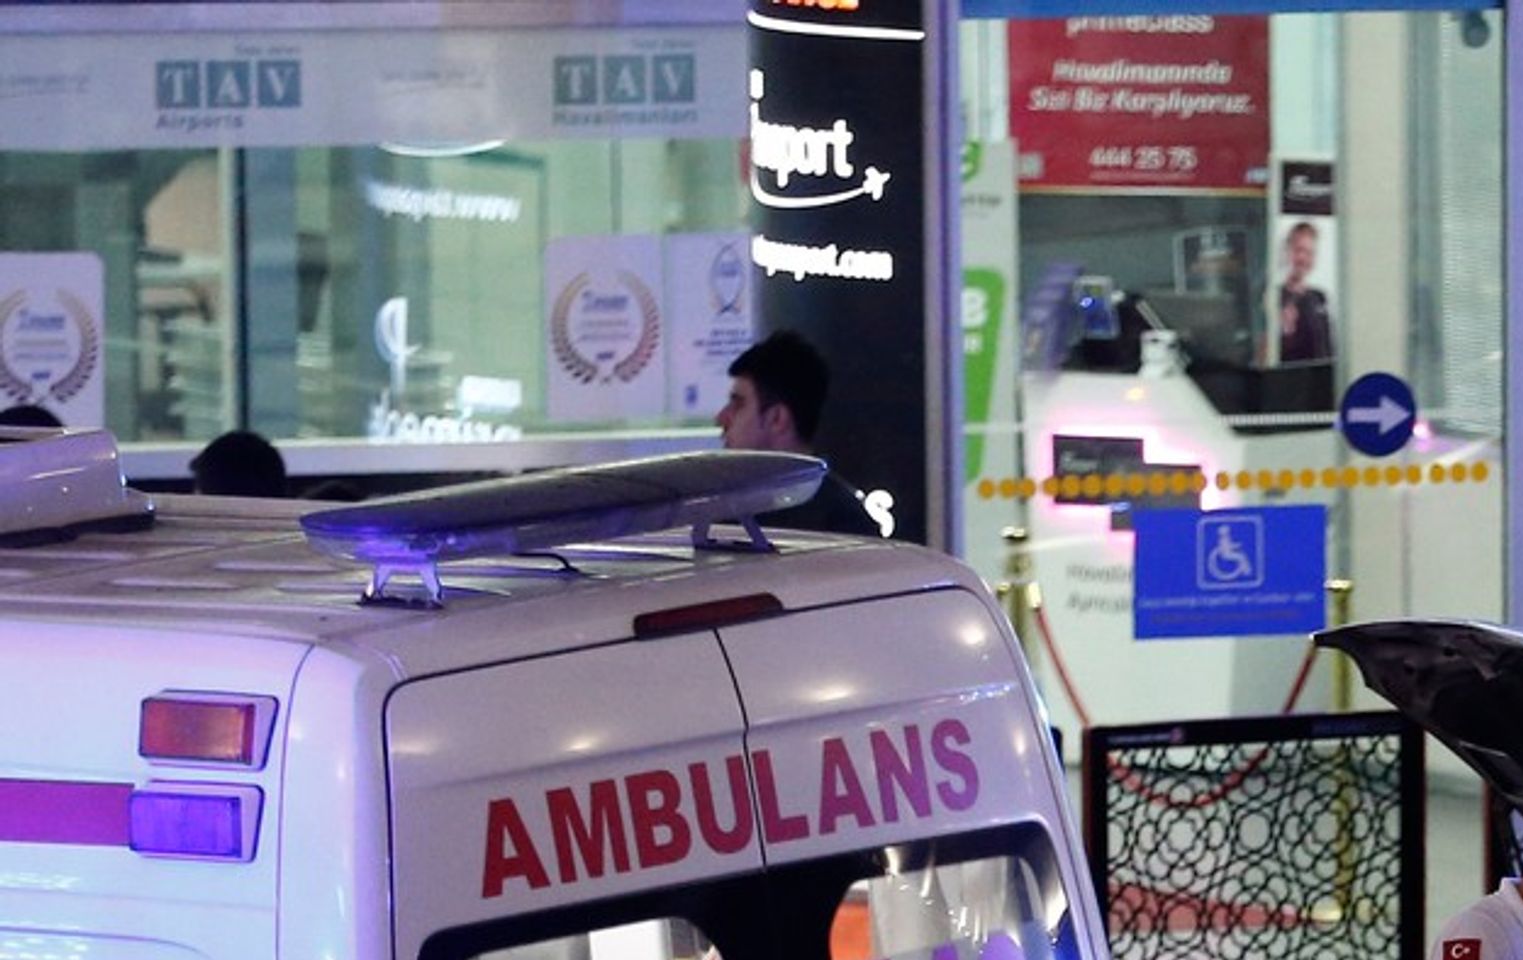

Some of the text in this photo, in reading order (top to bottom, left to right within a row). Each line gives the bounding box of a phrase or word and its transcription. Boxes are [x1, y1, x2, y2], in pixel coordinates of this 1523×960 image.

[158, 62, 299, 105] TAV
[556, 58, 692, 102] TAV
[481, 718, 981, 899] AMBULANS
